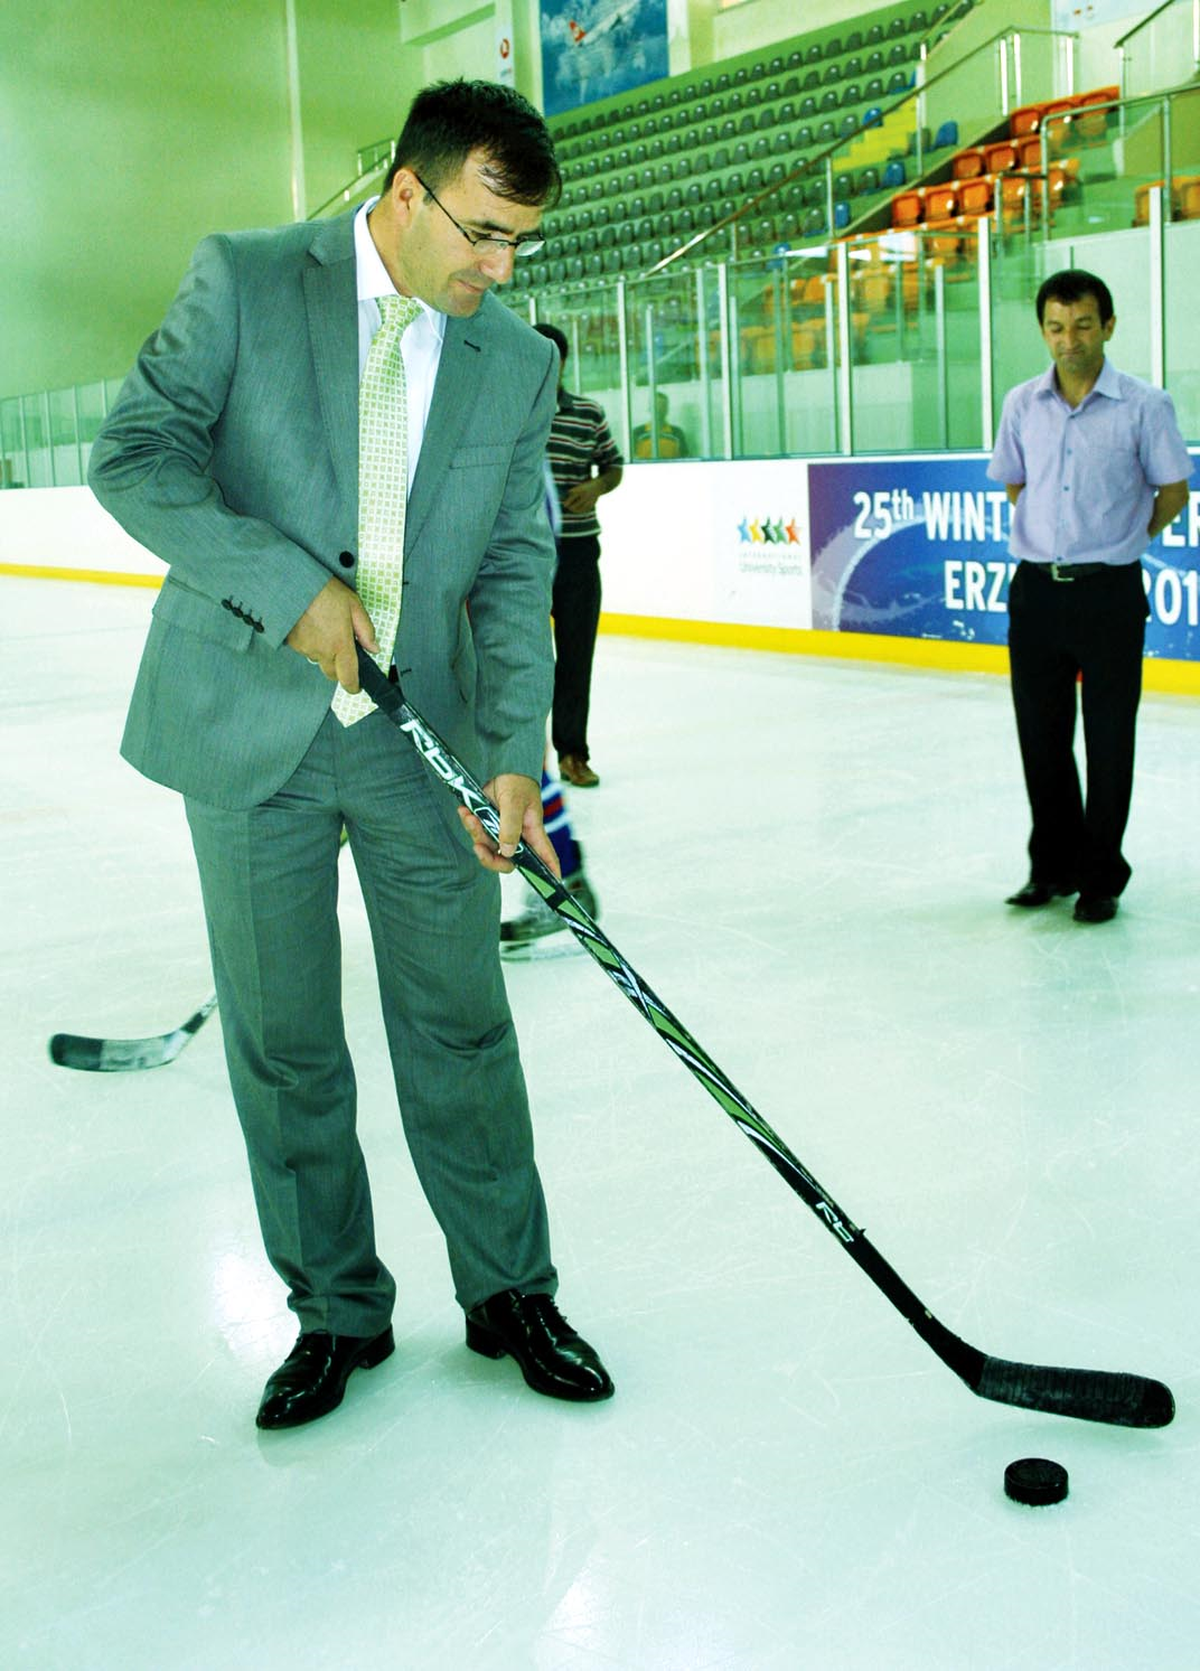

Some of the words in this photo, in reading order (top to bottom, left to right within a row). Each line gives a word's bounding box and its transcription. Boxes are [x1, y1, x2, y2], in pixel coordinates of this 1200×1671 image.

[853, 488, 914, 540] 25th
[922, 491, 1016, 542] WINT
[944, 560, 1017, 613] ERZ
